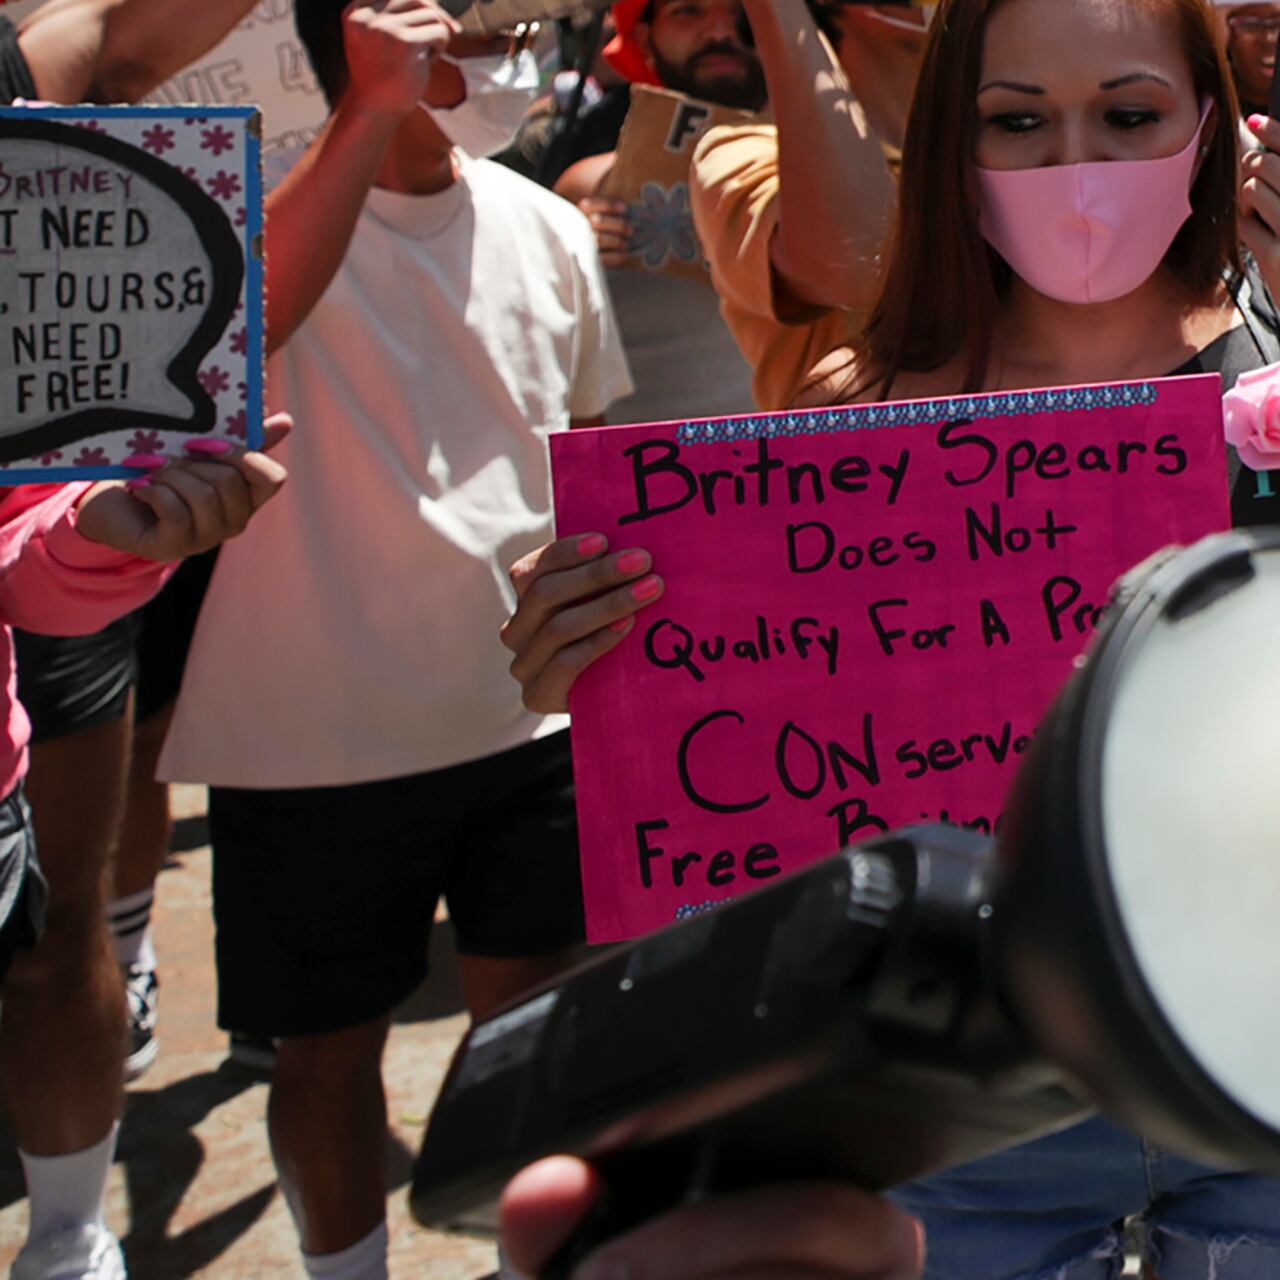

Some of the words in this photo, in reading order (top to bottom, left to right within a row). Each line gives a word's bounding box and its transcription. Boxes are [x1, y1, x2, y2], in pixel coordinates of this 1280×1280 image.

[41, 205, 149, 251] NEED
[12, 322, 123, 366] NEED
[17, 361, 130, 414] FREE!
[618, 437, 910, 524] Britney
[936, 419, 1188, 498] Spears
[785, 522, 937, 574] Does
[964, 502, 1077, 561] Not
[643, 615, 840, 682] Qualify
[867, 598, 956, 656] For
[980, 599, 1011, 647] A
[634, 819, 783, 889] Free
